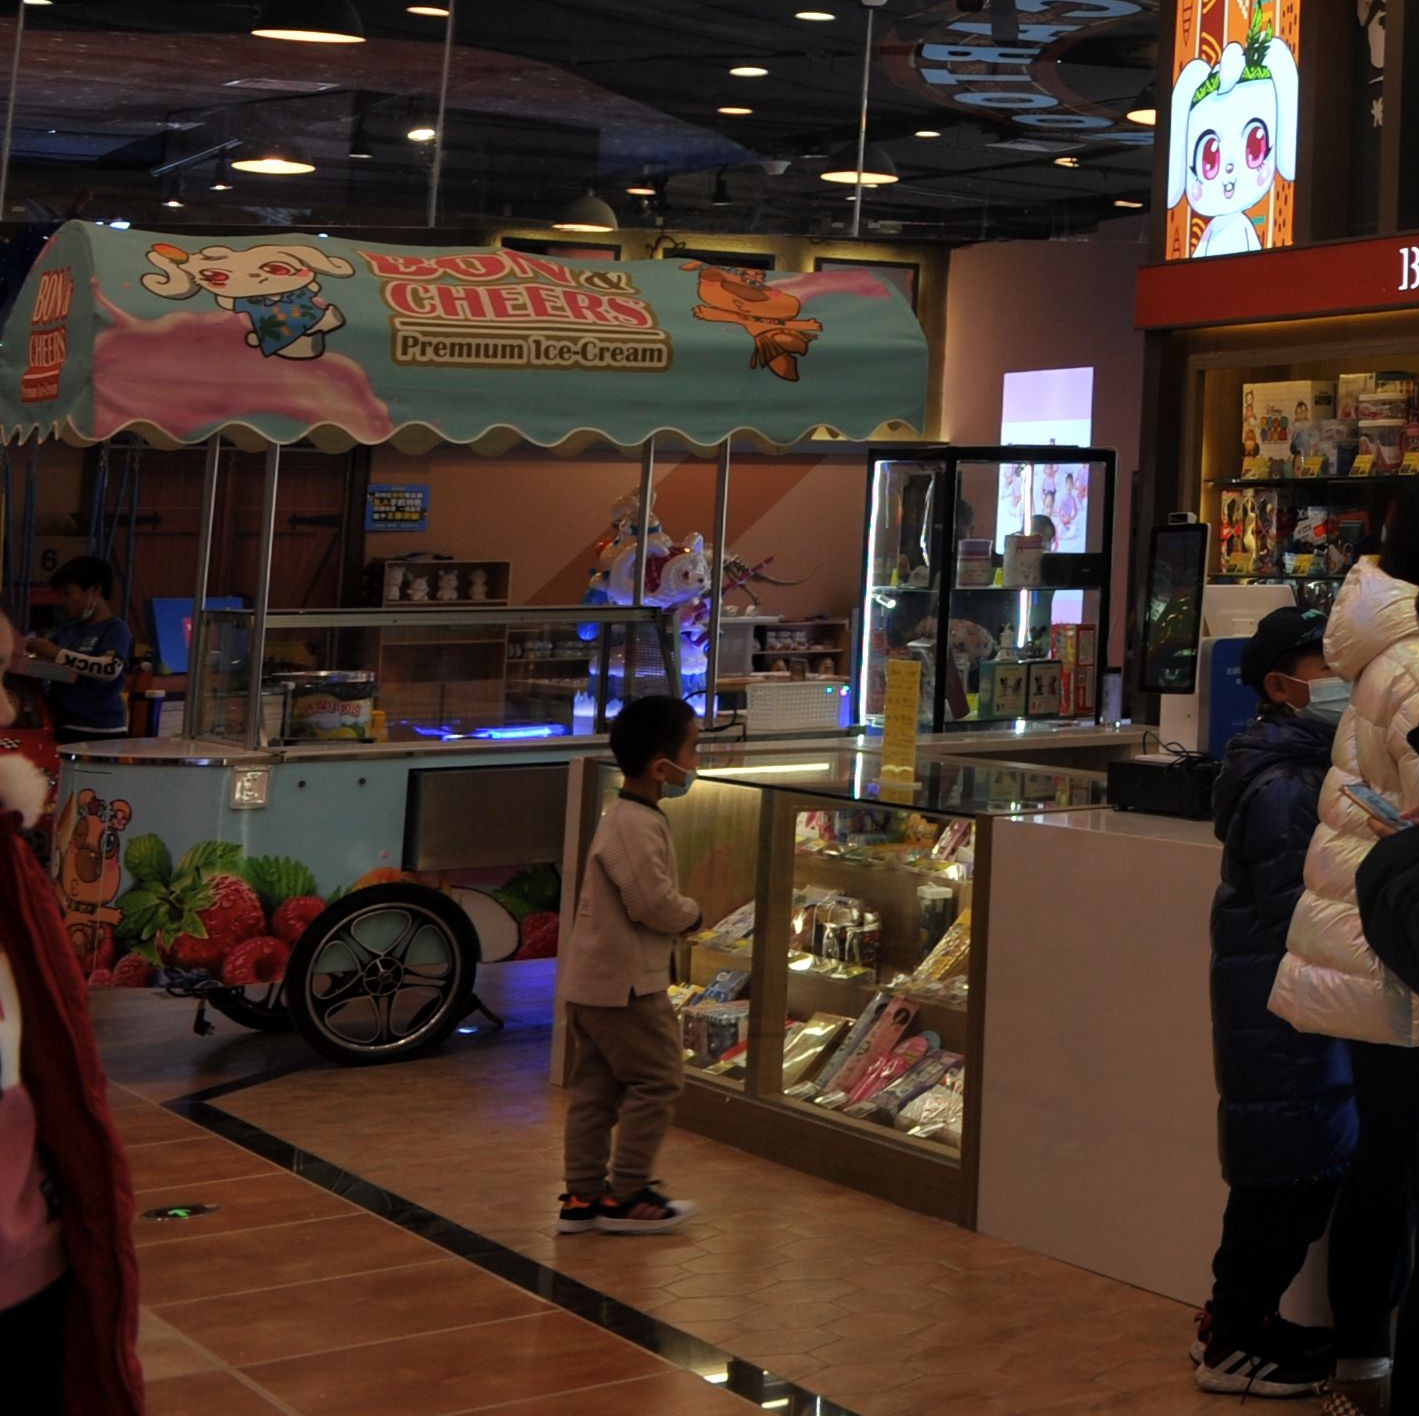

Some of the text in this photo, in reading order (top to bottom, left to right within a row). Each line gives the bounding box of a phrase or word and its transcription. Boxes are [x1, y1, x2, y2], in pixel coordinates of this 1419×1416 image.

[358, 248, 576, 284] BON
[385, 280, 653, 327] CHEERS
[400, 334, 664, 363] Premium Ice-Cream
